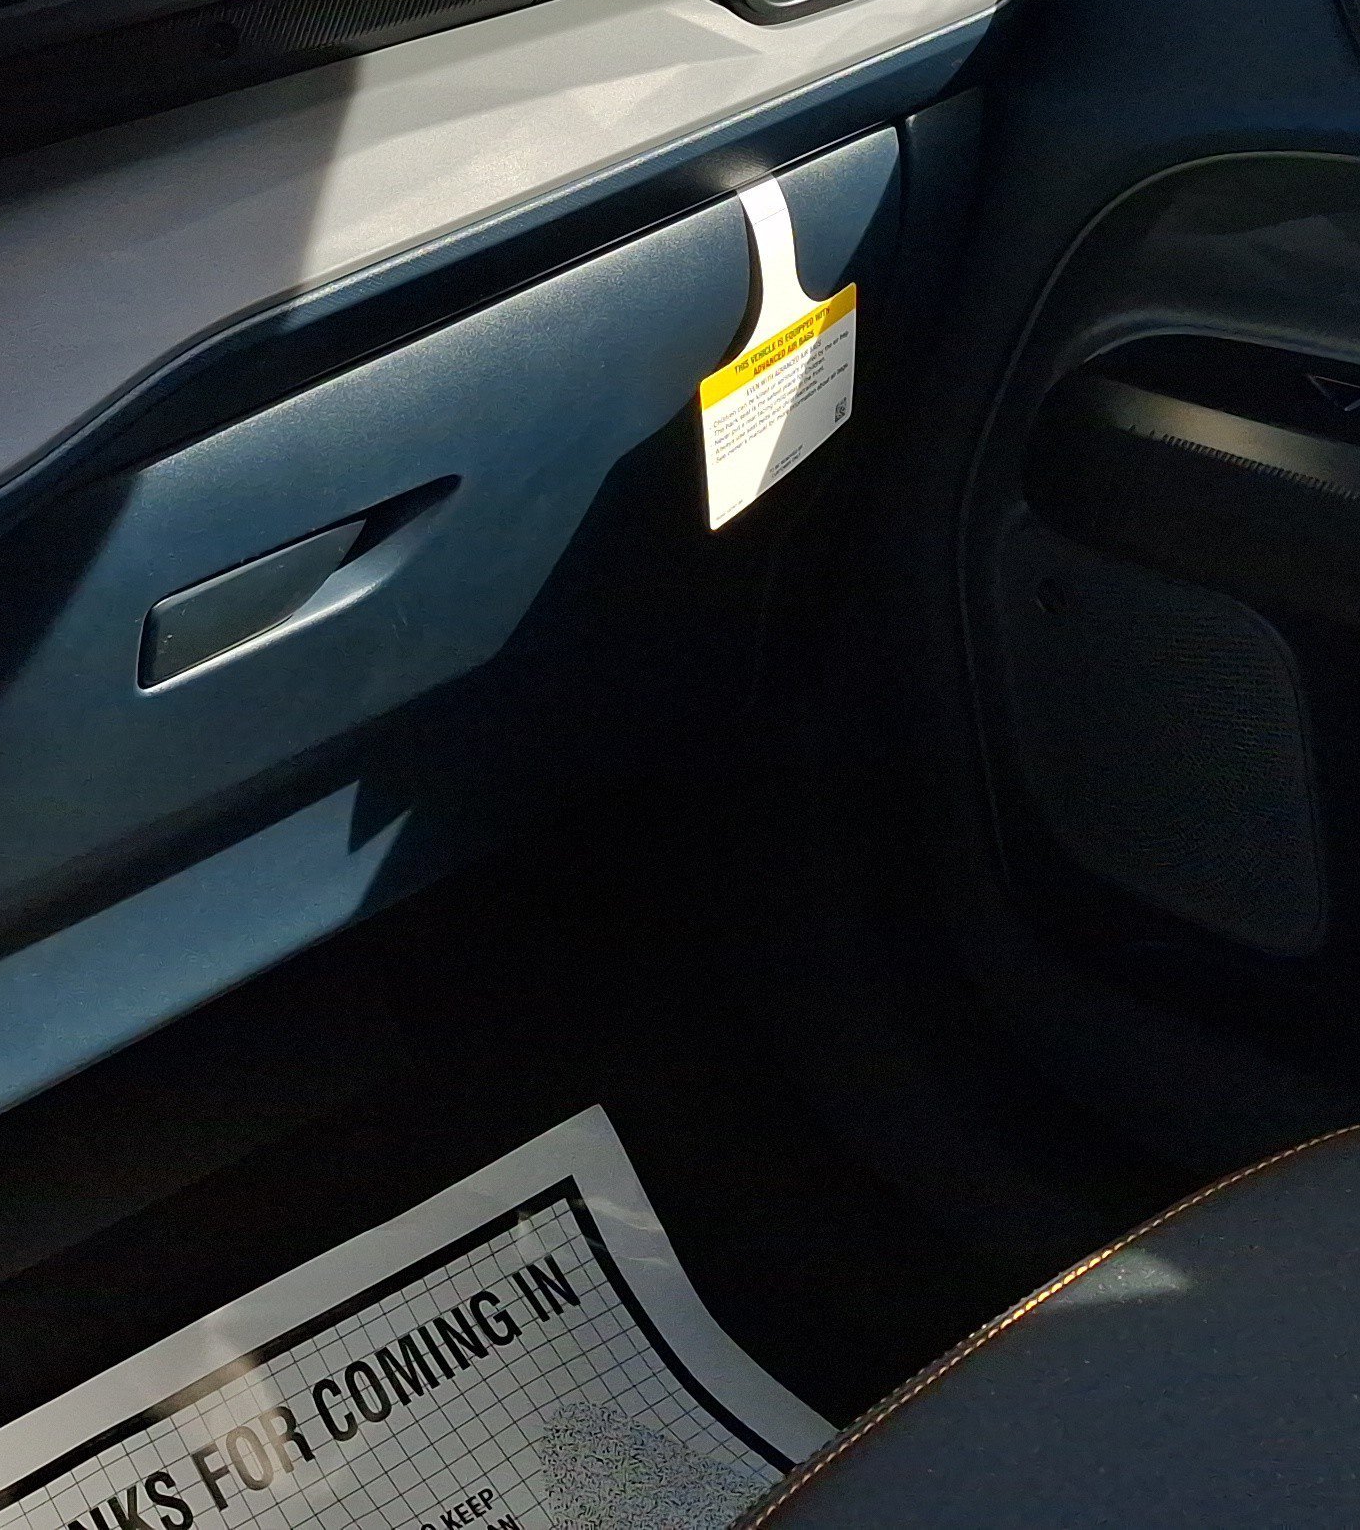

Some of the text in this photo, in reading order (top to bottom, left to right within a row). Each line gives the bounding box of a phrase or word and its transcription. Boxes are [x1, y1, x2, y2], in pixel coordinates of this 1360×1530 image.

[191, 1405, 316, 1512] FOR
[312, 1290, 523, 1443] COMING
[512, 1254, 581, 1323] IN
[440, 1488, 494, 1530] KEEP
